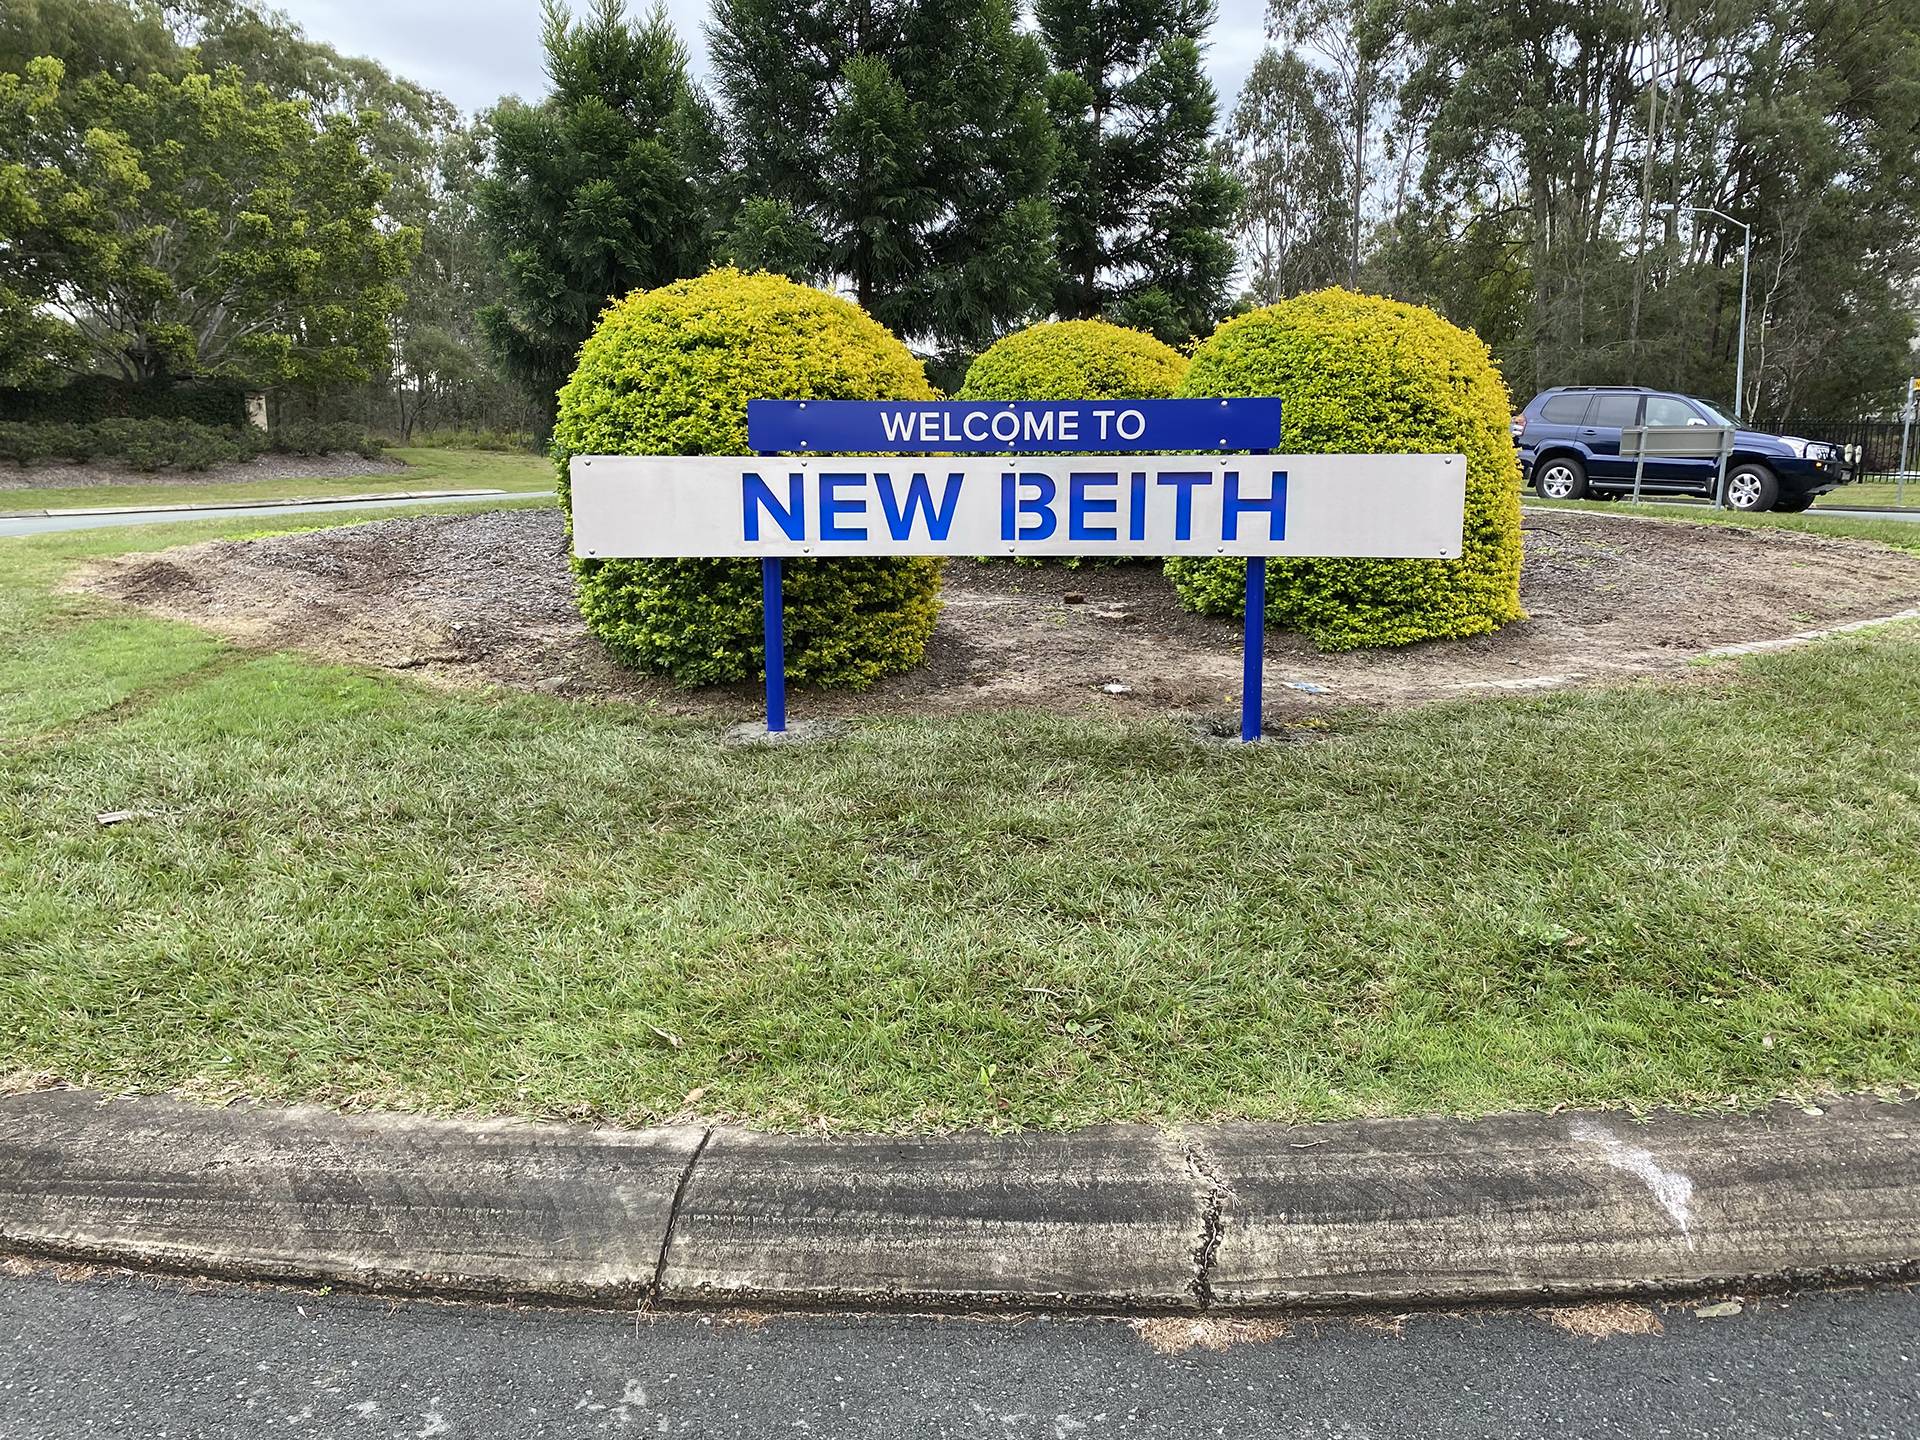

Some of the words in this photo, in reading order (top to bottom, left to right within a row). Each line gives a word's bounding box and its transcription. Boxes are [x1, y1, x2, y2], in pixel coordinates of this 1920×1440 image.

[880, 410, 1080, 441] WELCOME
[1092, 410, 1146, 440] TO
[742, 473, 964, 541] NEW
[1001, 472, 1288, 541] BEITH
